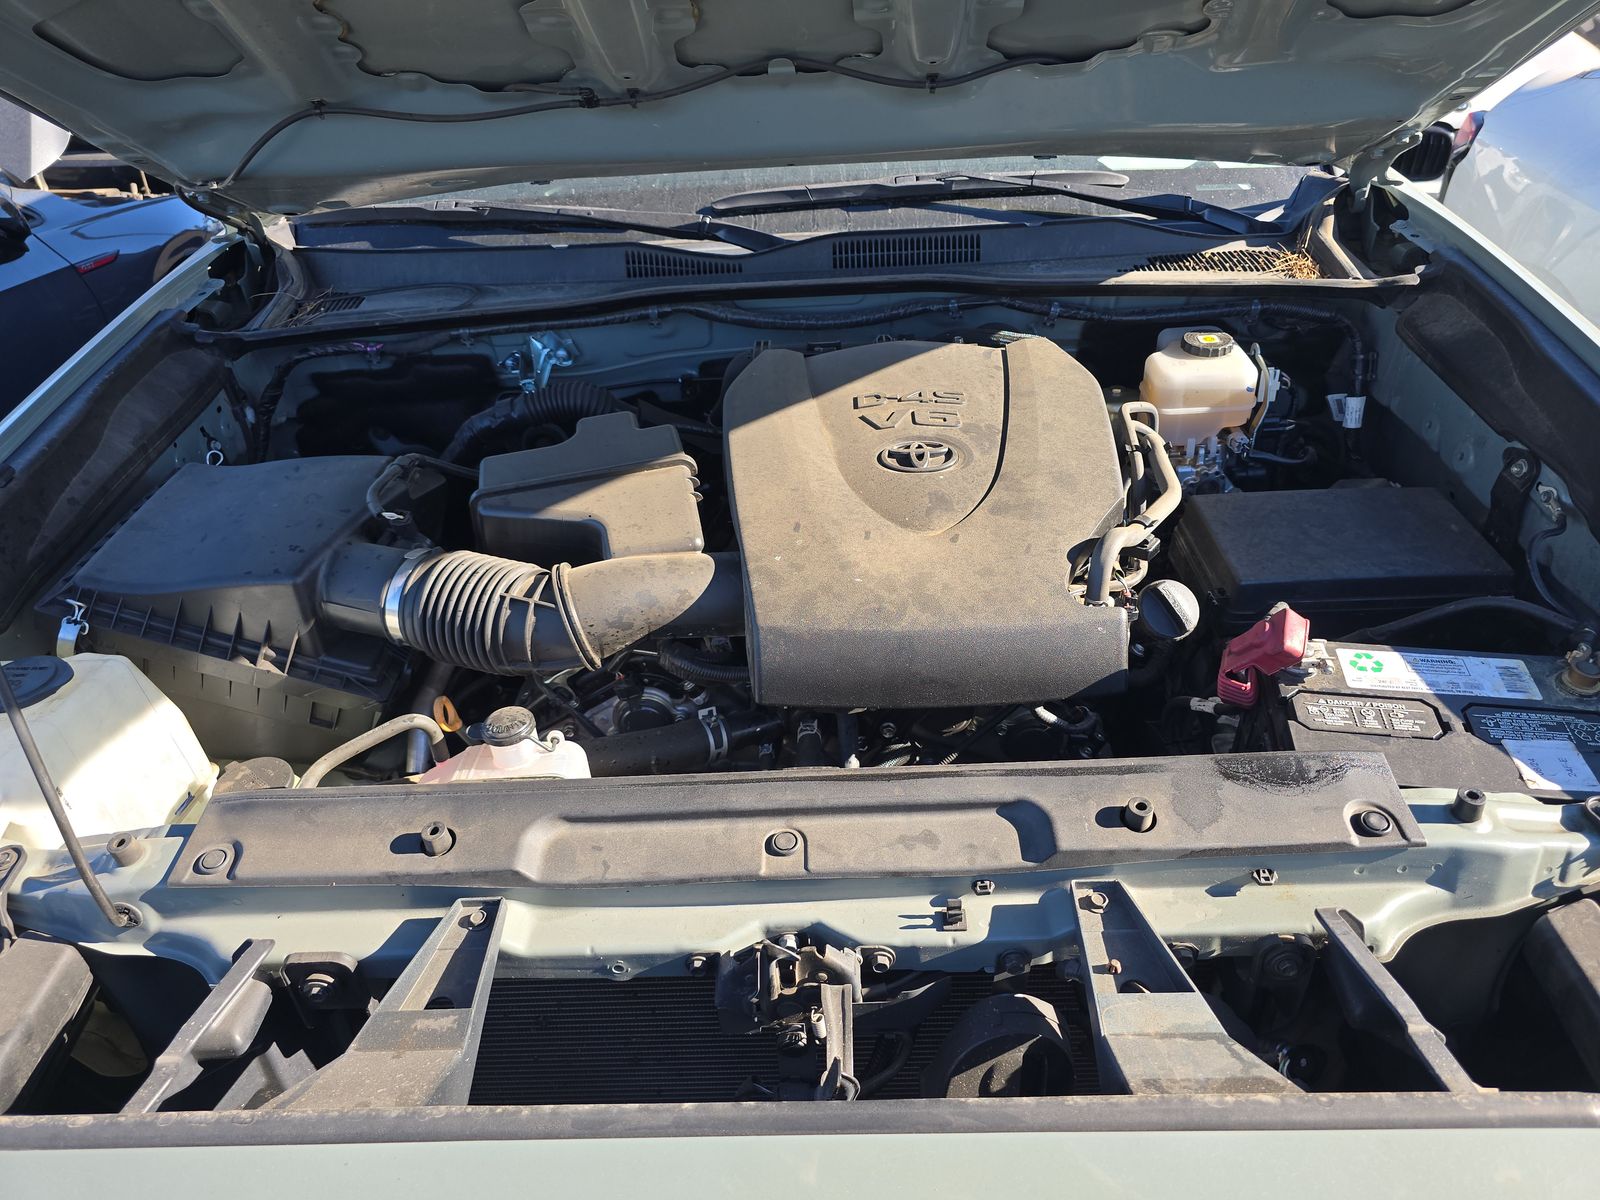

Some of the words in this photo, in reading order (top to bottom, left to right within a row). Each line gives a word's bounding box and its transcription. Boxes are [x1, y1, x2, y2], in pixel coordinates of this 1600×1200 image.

[853, 391, 966, 410] D-4S
[858, 410, 962, 430] V6
[1327, 699, 1363, 707] DANGER
[1373, 702, 1405, 710] POISON
